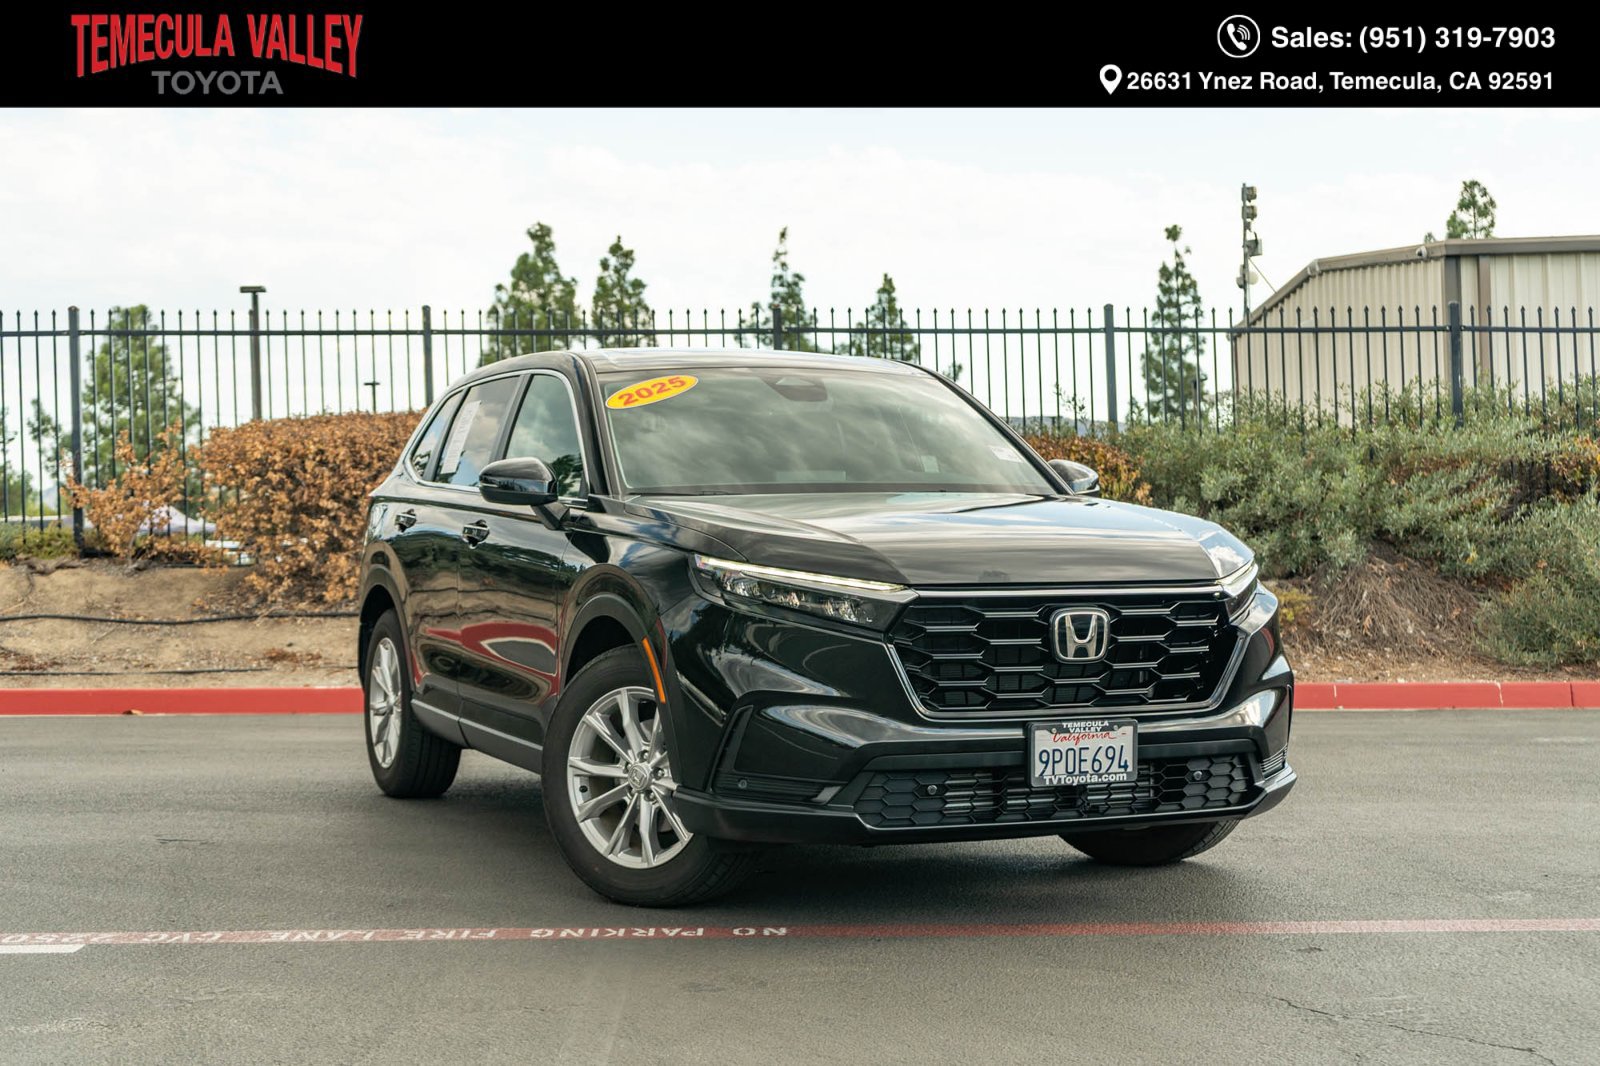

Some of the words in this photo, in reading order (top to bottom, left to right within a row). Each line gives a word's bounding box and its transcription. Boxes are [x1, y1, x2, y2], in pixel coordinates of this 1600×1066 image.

[618, 377, 686, 406] 2025
[1062, 720, 1109, 728] TEMECULA
[1052, 732, 1117, 745] California
[1043, 773, 1127, 786] TVToyota.com
[263, 931, 376, 942] LANE
[400, 929, 497, 939] FIRE
[530, 927, 705, 938] PARKING
[732, 927, 787, 936] NO
